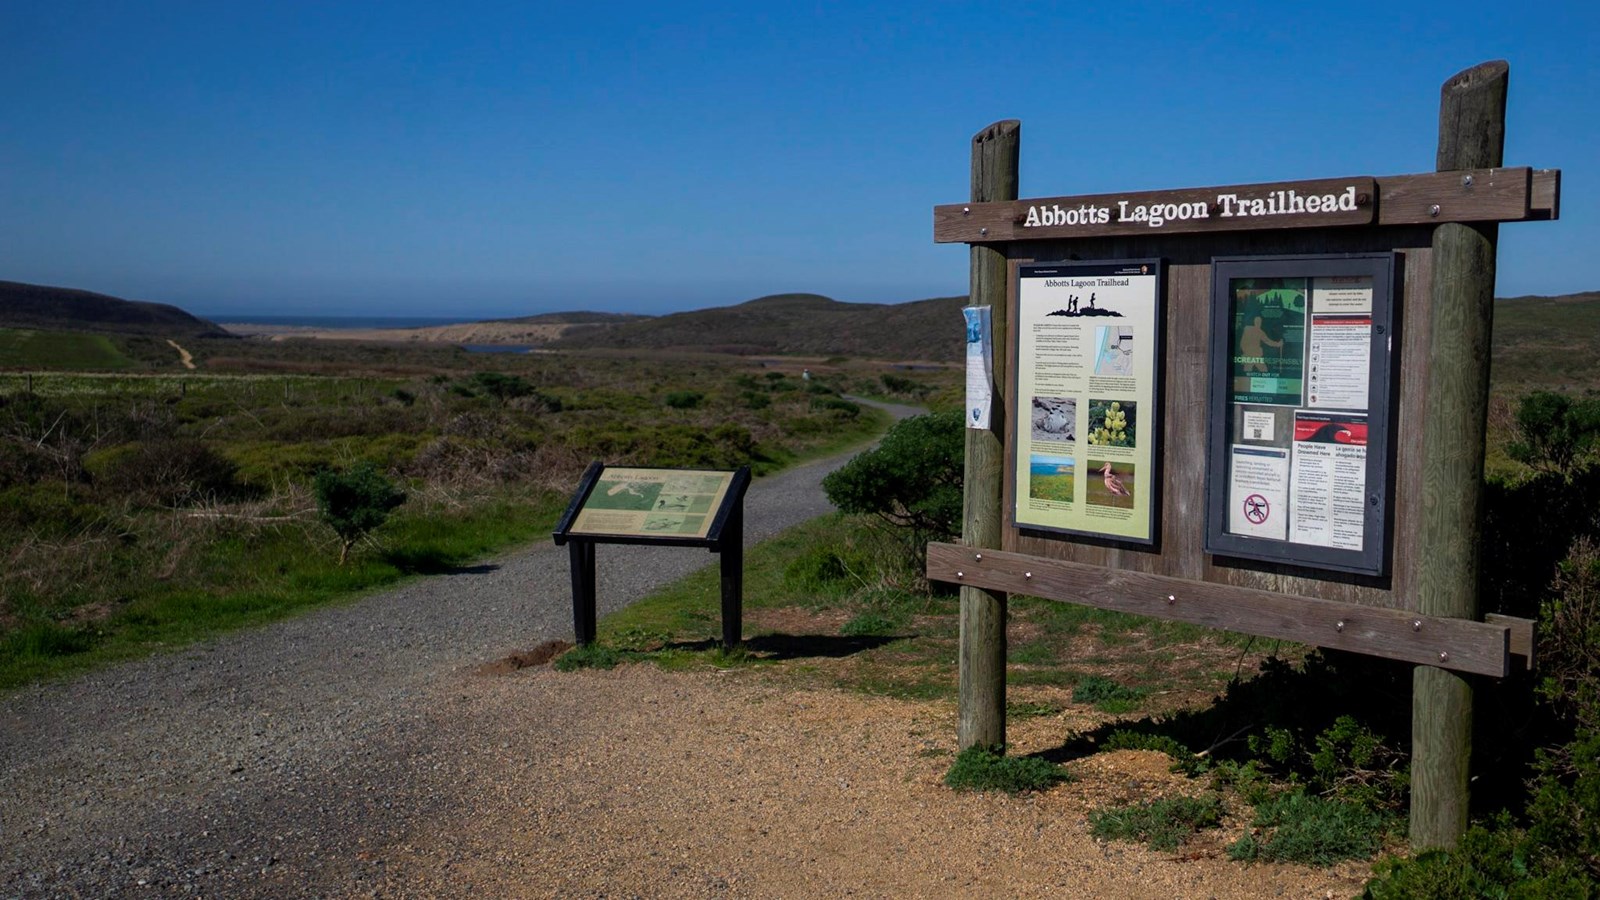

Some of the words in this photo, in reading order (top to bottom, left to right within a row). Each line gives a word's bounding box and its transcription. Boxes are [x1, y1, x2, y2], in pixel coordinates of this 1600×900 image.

[1024, 203, 1110, 228] Abbotts
[1117, 200, 1210, 227] Lagoon
[1217, 187, 1358, 217] Trailhead
[1044, 279, 1070, 288] Abbotts
[1071, 279, 1096, 289] Lagoon
[1097, 278, 1129, 287] Trailhead
